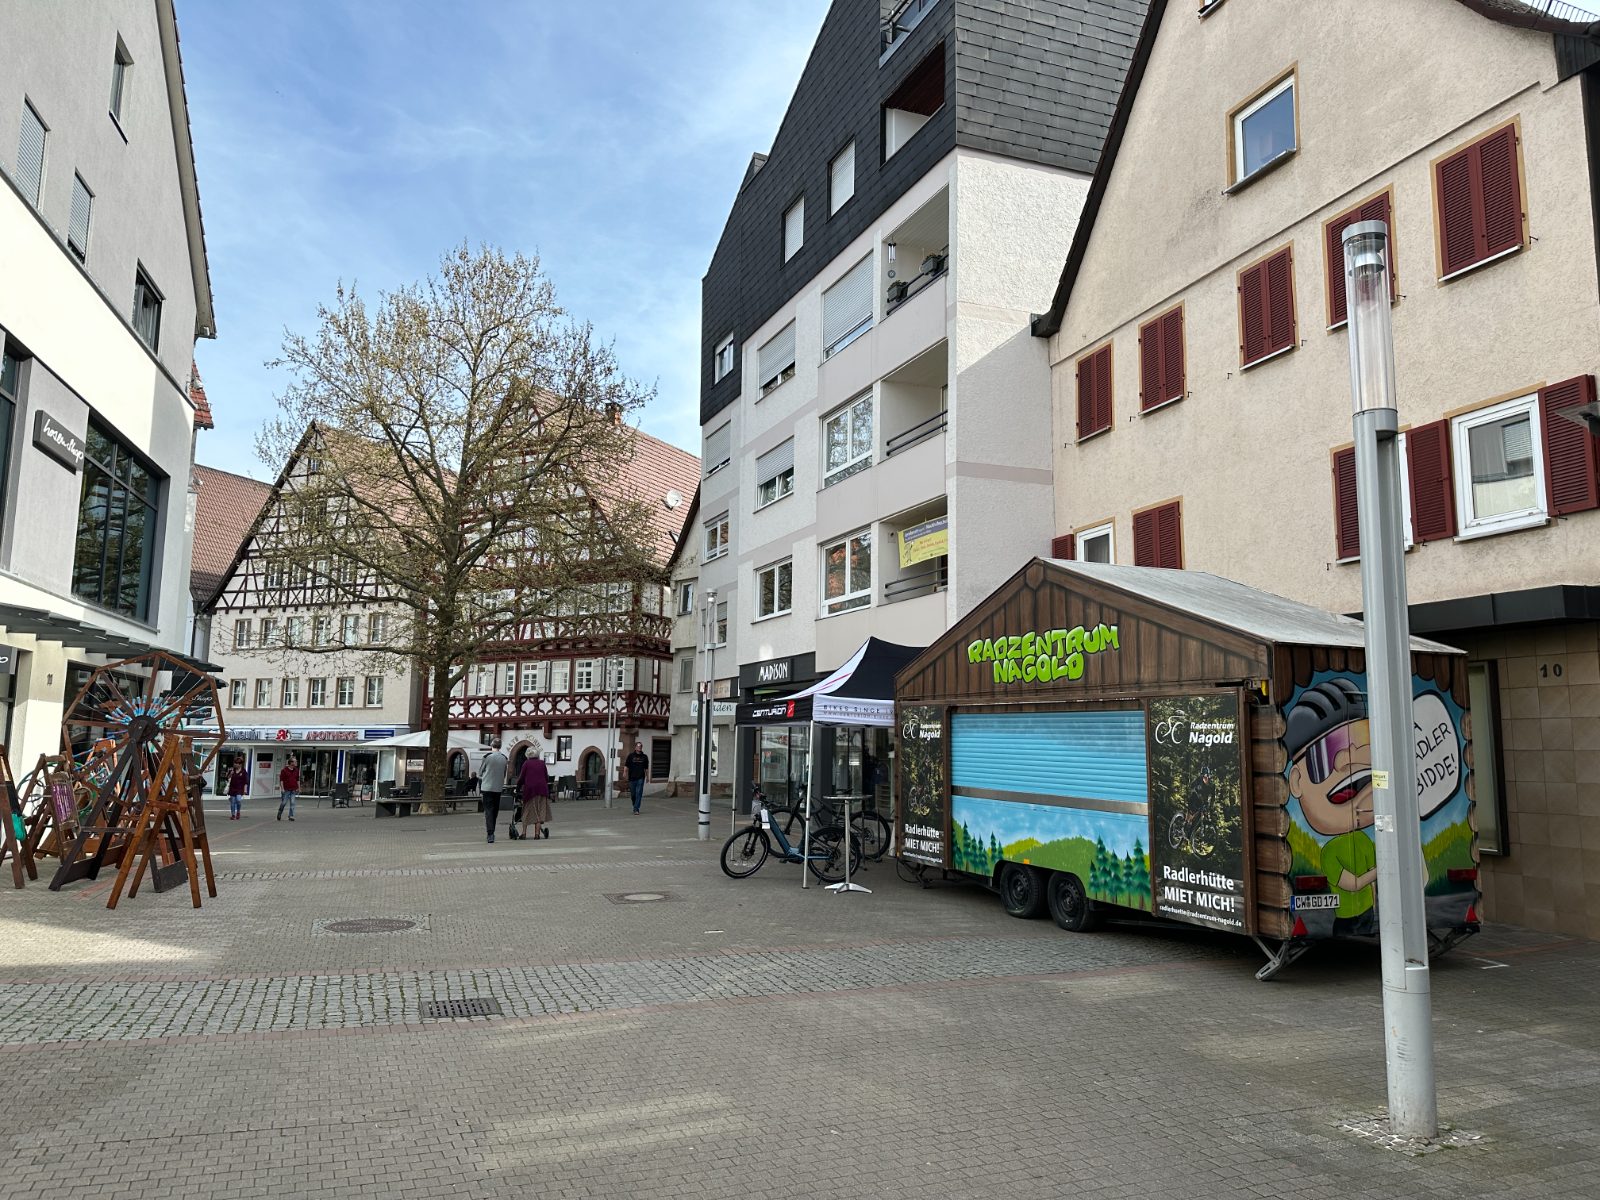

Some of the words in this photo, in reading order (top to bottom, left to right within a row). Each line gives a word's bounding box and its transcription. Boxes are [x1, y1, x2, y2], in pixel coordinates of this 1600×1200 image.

[967, 622, 1120, 664] RADZENTRUM
[992, 652, 1085, 684] NAGOLD
[1540, 663, 1563, 678] 10
[1190, 721, 1234, 730] Radzentrum
[919, 729, 941, 741] Nagold
[1188, 731, 1233, 747] Nagold
[1416, 722, 1452, 760] ADLER
[904, 823, 940, 839] Radlerhütte
[905, 837, 920, 850] MIET
[920, 840, 940, 853] MICH!
[1163, 865, 1235, 891] Radlerhütte
[1164, 886, 1194, 904] MIET
[1196, 891, 1235, 913] MICH!
